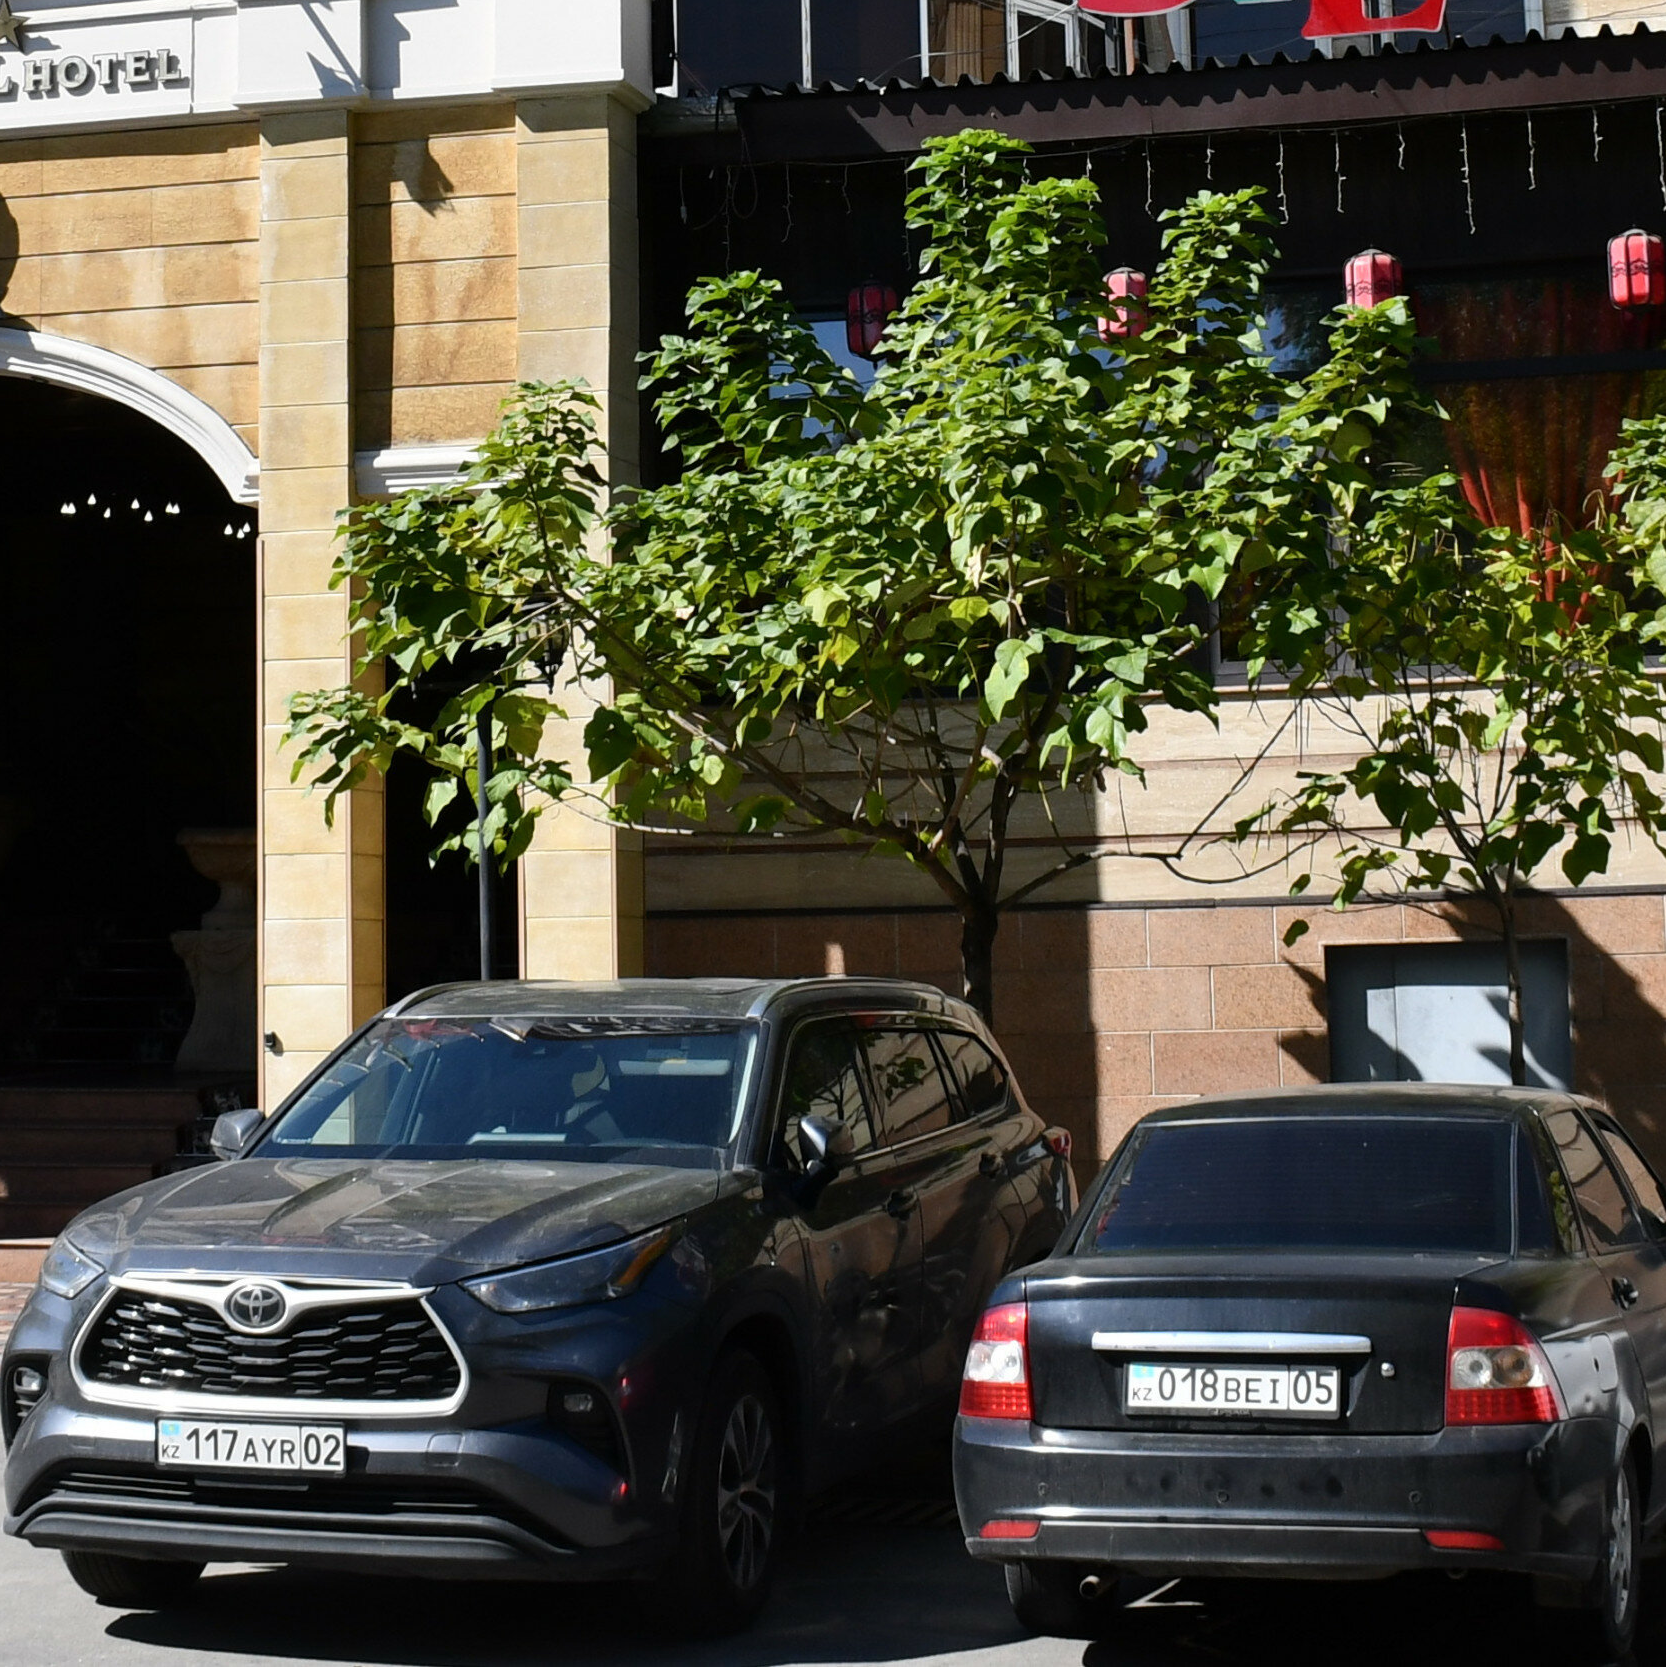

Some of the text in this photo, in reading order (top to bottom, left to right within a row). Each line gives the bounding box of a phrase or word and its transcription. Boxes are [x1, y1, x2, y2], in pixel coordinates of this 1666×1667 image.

[24, 49, 183, 94] HOTEL
[1133, 1387, 1152, 1401] KZ
[1293, 1369, 1333, 1405] 05
[161, 1444, 180, 1459] KZ
[303, 1433, 341, 1466] 02
